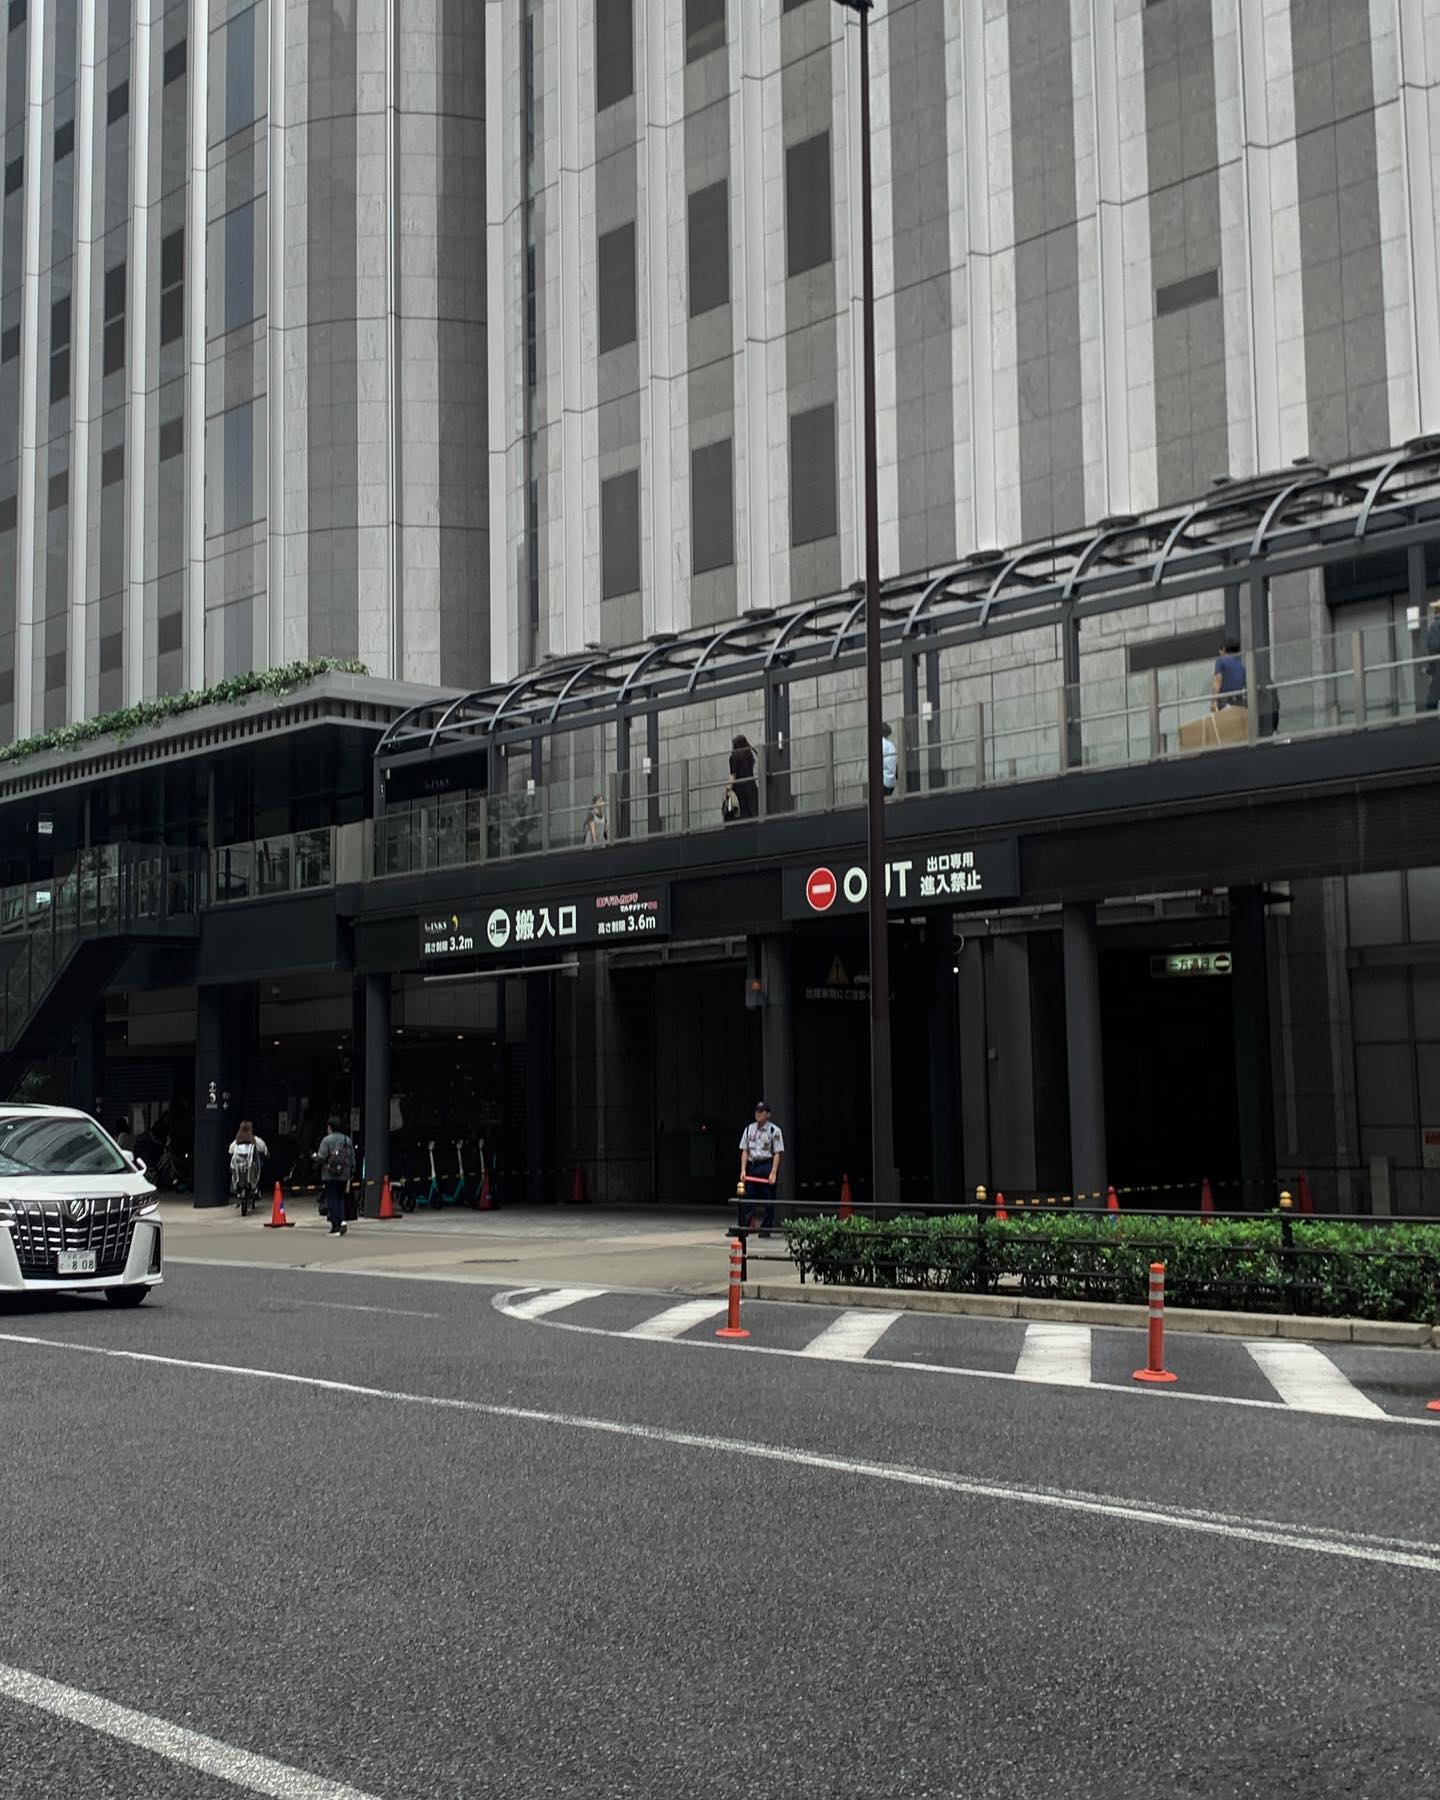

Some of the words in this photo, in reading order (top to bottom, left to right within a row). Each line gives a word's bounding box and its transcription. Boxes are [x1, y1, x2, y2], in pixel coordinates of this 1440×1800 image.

[927, 851, 974, 872] 出口専用
[843, 860, 913, 903] OT
[920, 870, 982, 897] 進入禁止
[515, 905, 577, 942] 搬入口
[627, 914, 656, 931] 3.6m
[449, 935, 473, 952] 3.2m
